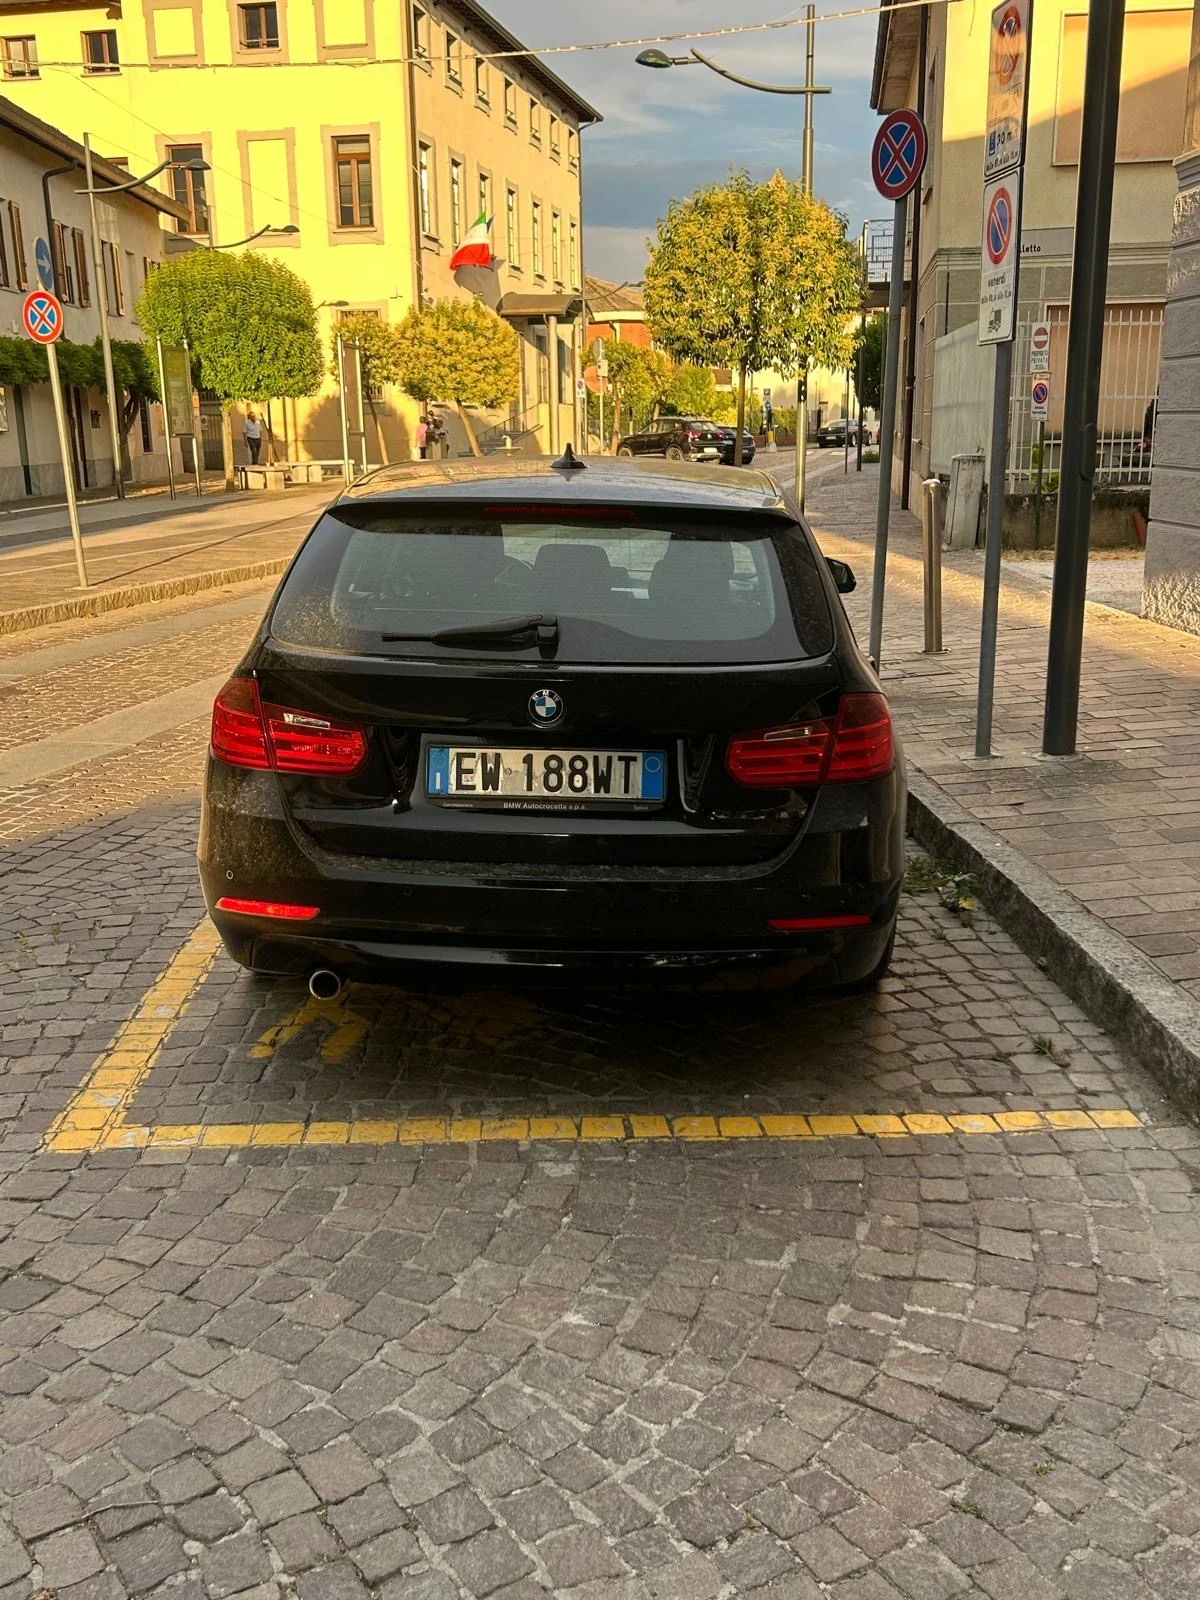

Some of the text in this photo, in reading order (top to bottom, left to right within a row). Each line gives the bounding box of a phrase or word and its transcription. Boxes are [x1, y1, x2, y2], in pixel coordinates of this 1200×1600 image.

[997, 131, 1005, 146] 30
[1020, 244, 1041, 253] letto
[531, 689, 561, 702] BMW
[455, 752, 637, 794] EW 188WT
